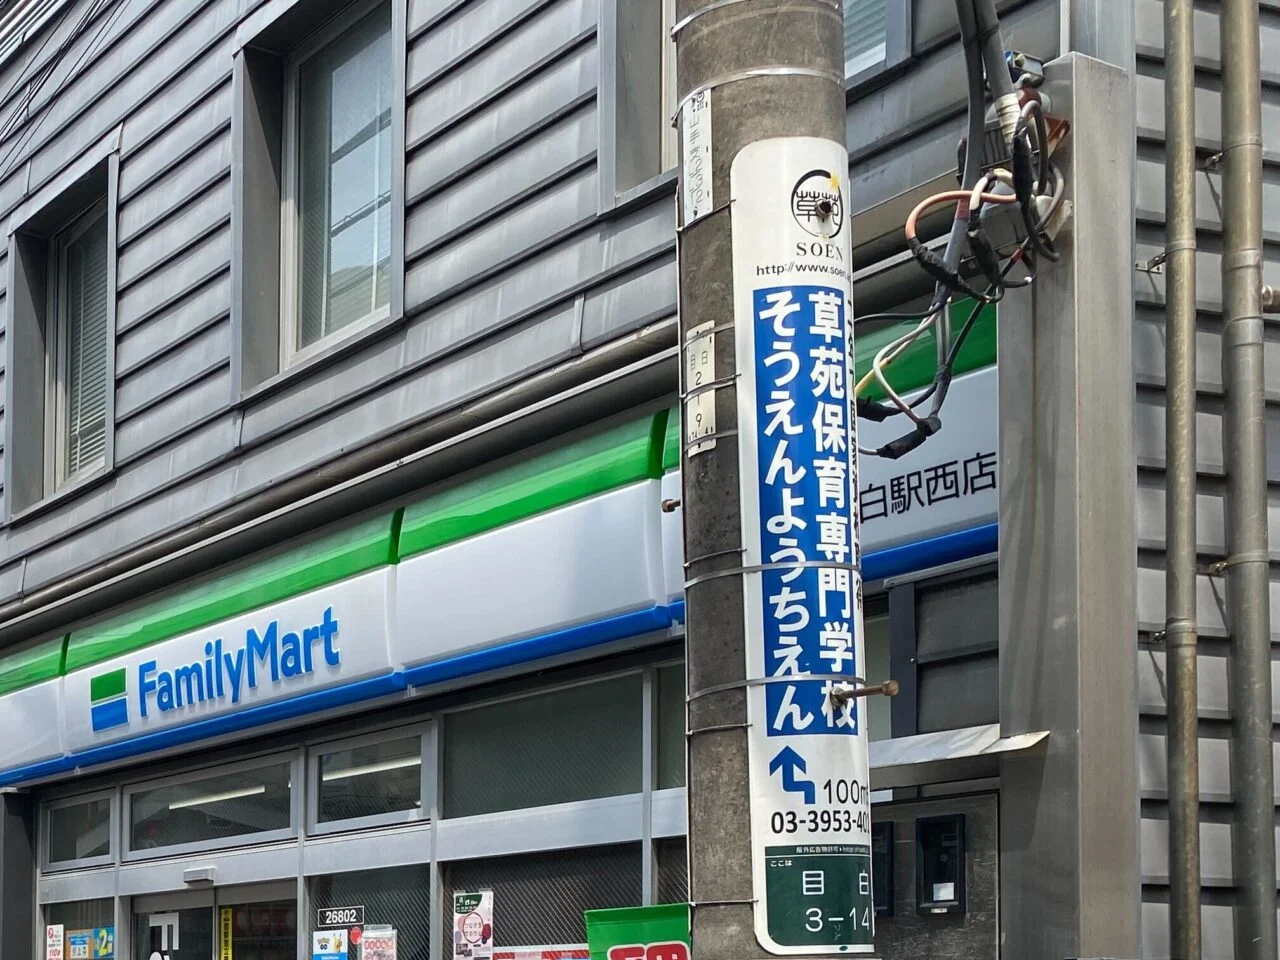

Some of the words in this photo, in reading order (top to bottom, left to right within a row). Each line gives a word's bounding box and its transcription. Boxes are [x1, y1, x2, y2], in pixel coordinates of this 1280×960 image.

[795, 242, 844, 261] SOEN
[757, 289, 816, 733] そうえんようちえん
[806, 290, 858, 729] 草苑保育専門学校
[859, 451, 997, 524] 白駅西店
[138, 604, 342, 719] FamilyMart
[770, 859, 793, 868] ここは
[325, 910, 357, 924] 26802
[805, 906, 870, 933] 3-14
